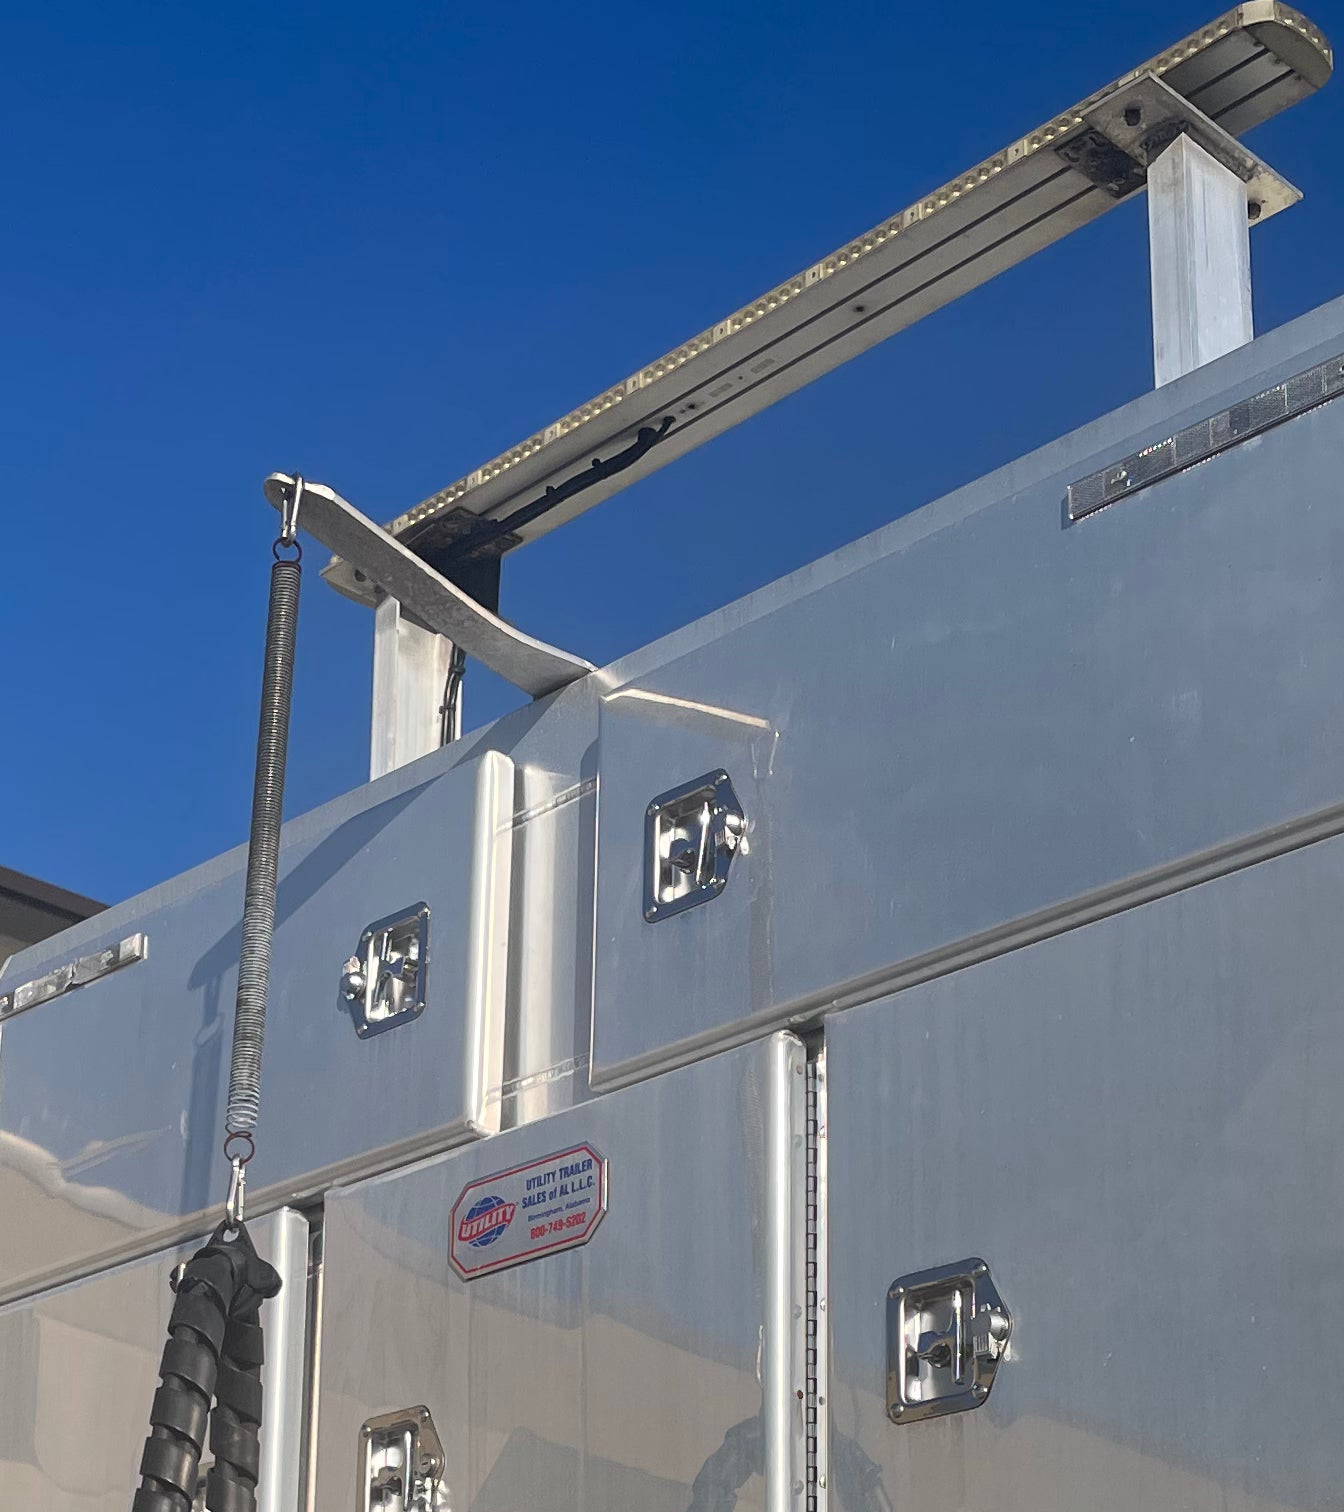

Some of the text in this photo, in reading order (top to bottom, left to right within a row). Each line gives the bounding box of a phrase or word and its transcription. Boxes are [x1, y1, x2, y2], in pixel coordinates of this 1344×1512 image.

[526, 1158, 593, 1191] UTILITY TRAILER
[522, 1190, 547, 1209] SALES
[549, 1187, 558, 1200] of
[559, 1184, 570, 1197] AL
[462, 1205, 514, 1238] UTILITY
